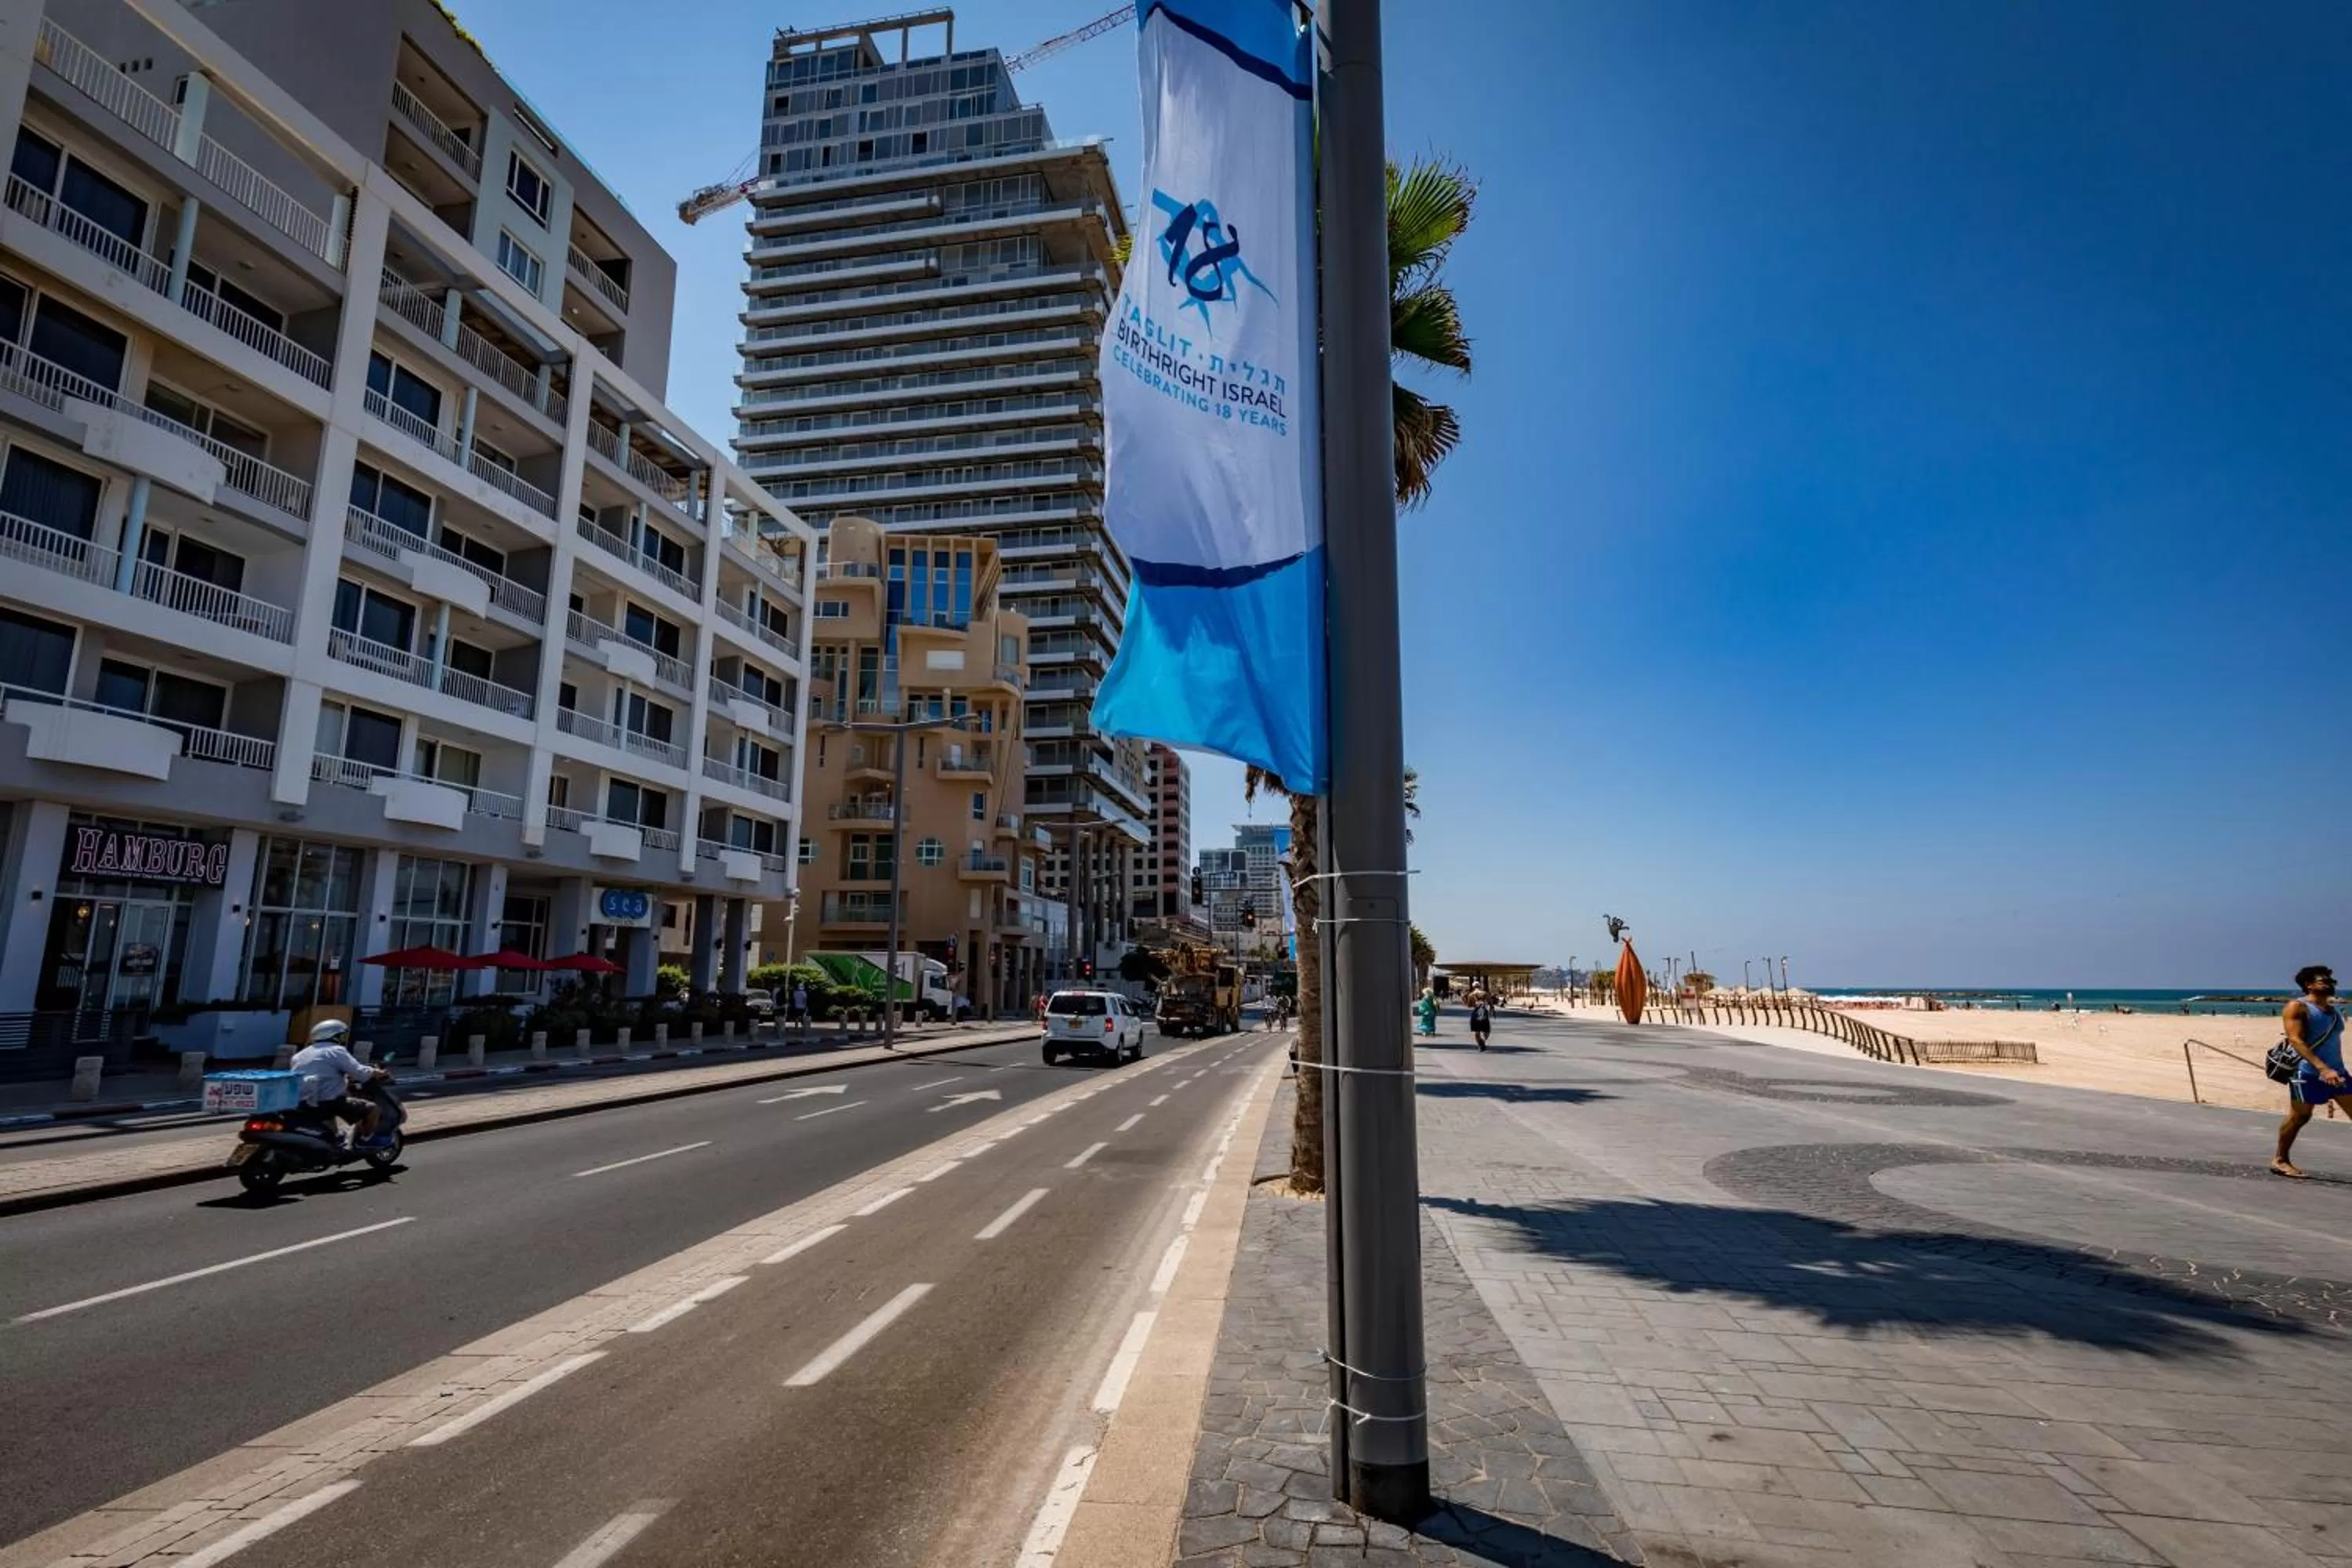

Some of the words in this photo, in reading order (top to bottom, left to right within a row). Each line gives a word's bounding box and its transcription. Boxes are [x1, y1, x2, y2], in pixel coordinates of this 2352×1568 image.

[1123, 292, 1192, 358] TAGLIT
[1112, 344, 1209, 412] CELEBRATING
[1215, 402, 1232, 420] 18
[1239, 408, 1287, 437] YEARS
[1116, 317, 1217, 395] BIRTHRIGHT
[1221, 381, 1287, 419] ISRAEL
[1209, 354, 1286, 394] תגלית
[71, 827, 227, 884] HAMBURG
